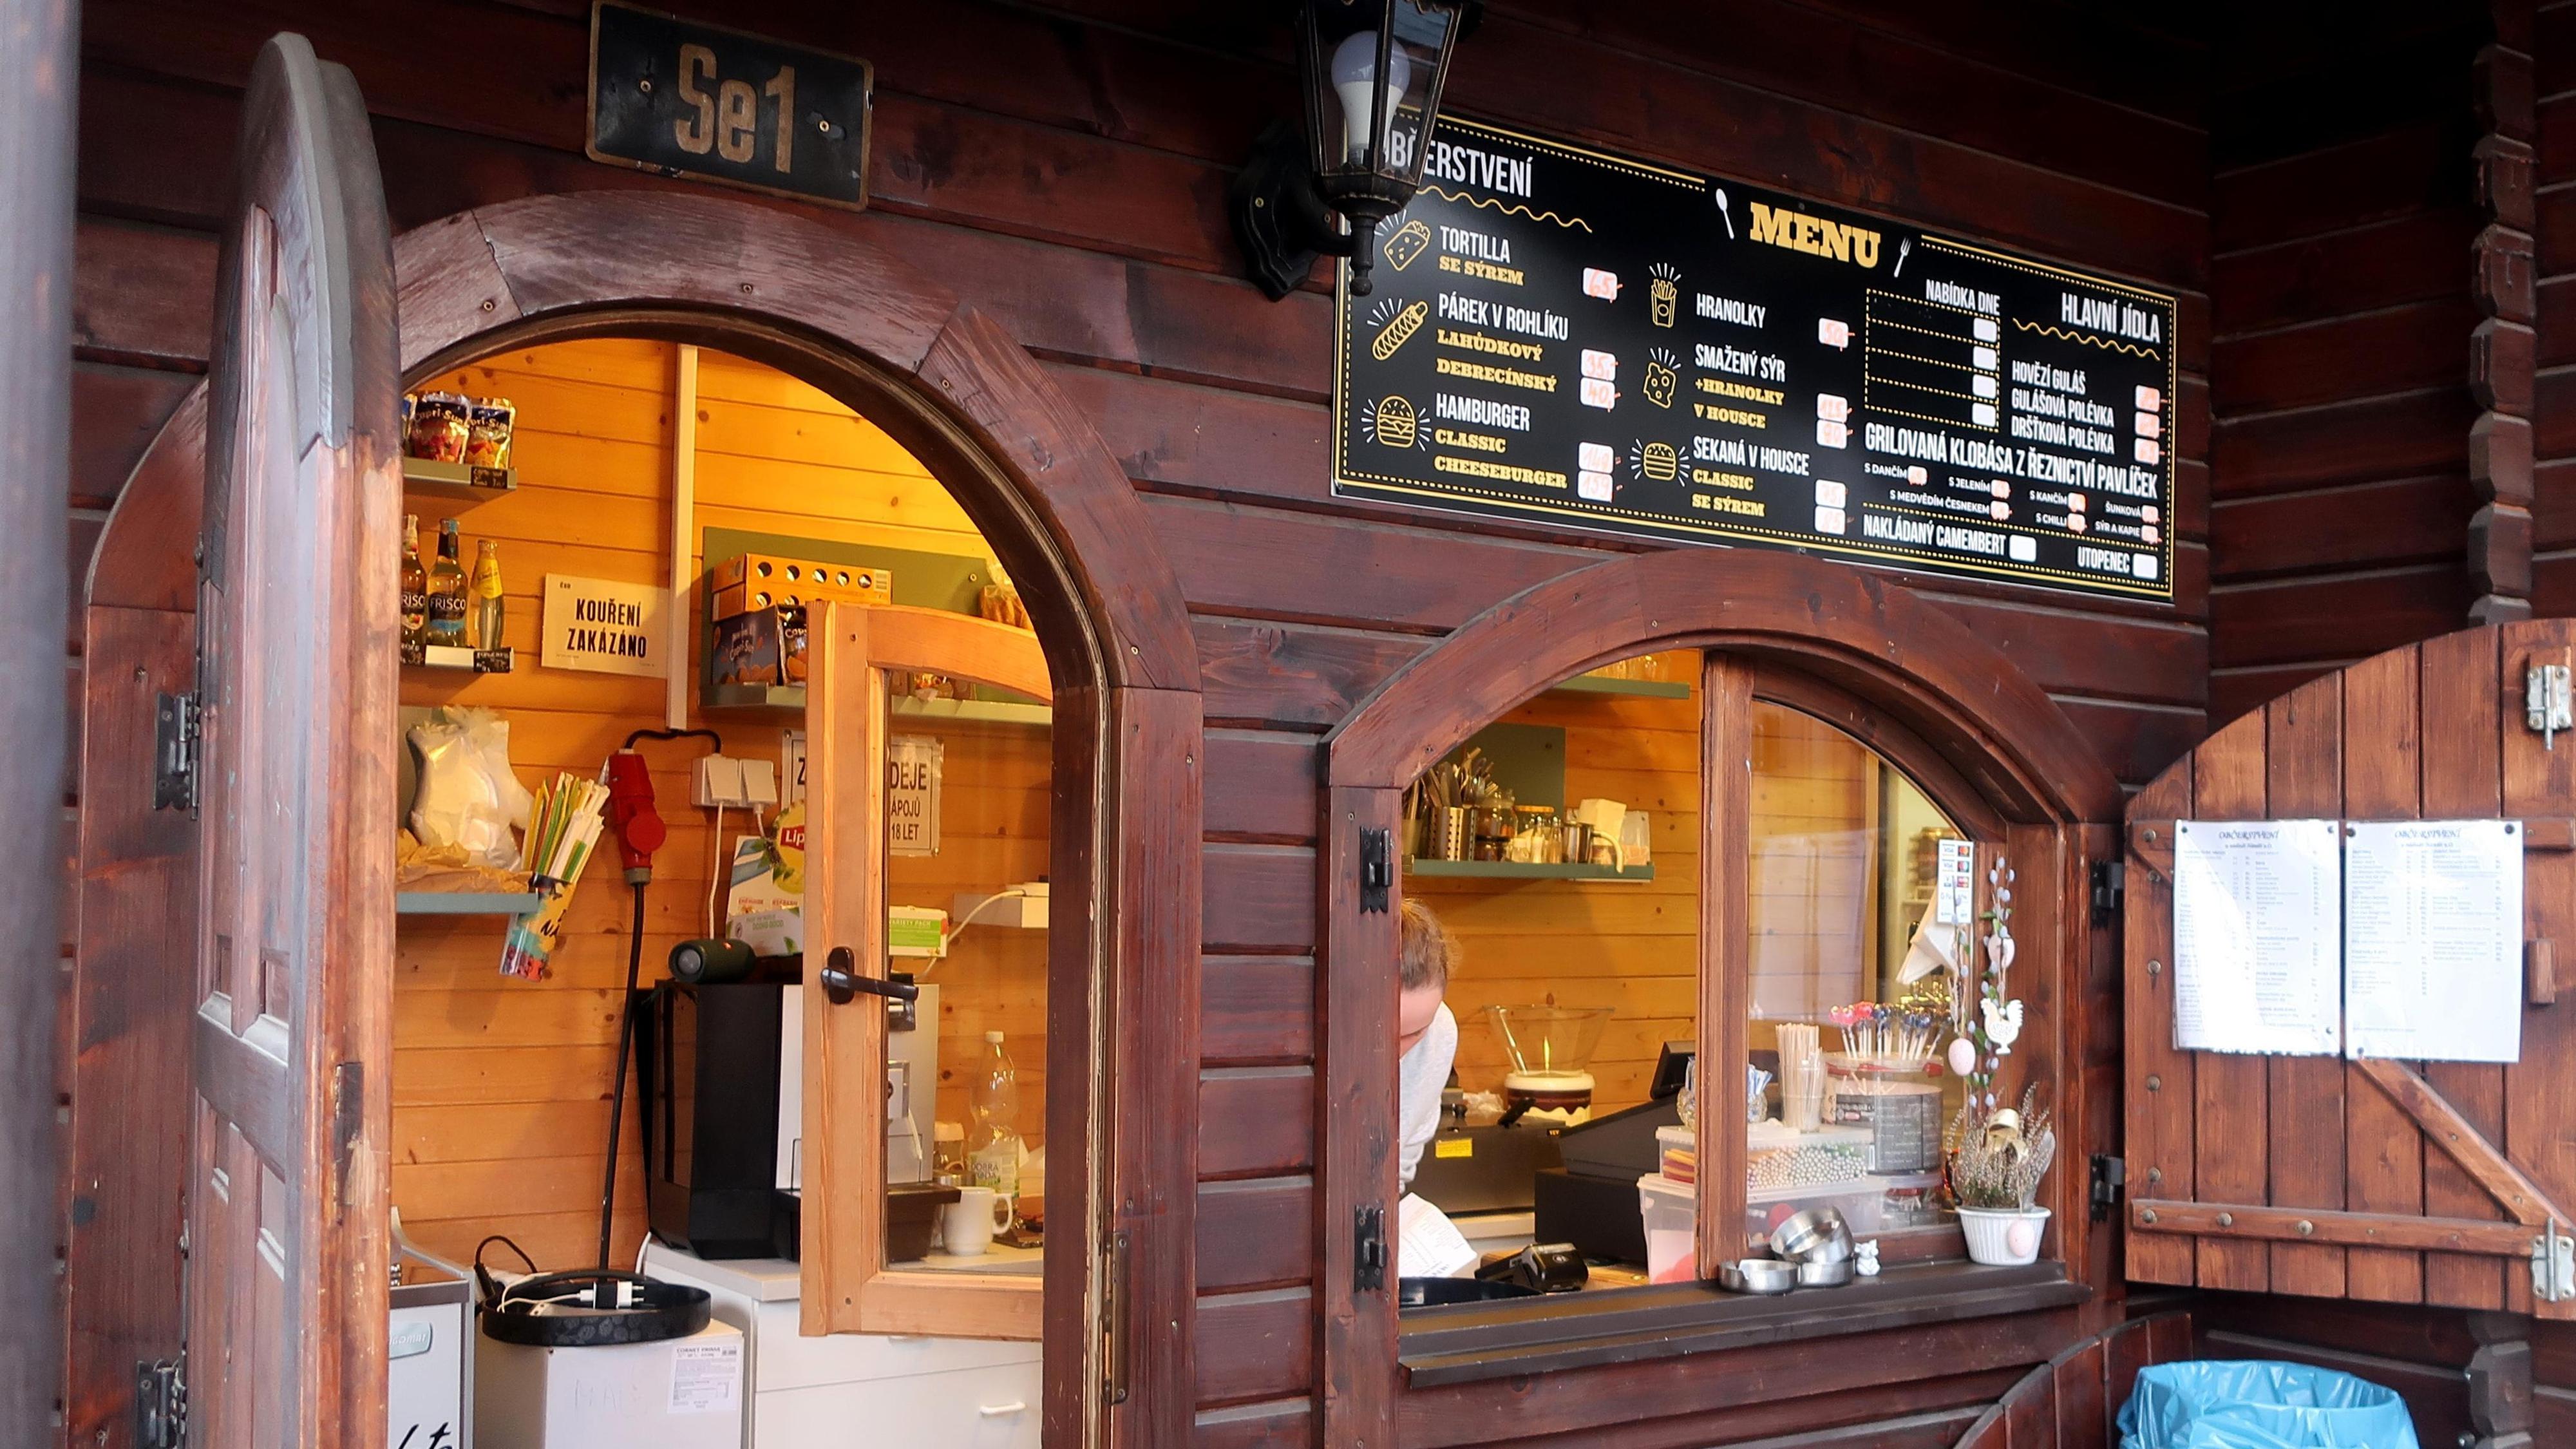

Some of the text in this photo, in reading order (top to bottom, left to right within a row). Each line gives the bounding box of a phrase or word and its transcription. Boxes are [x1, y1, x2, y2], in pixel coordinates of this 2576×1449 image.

[675, 43, 795, 174] Se1
[1439, 225, 1511, 264] TORTILLA
[1750, 202, 1881, 269] MENU
[1439, 255, 1524, 286] SE SÝREM
[1696, 292, 1766, 329] HRANOLKY
[1926, 278, 2001, 316] NABÍDKA DNE
[1438, 291, 1569, 341] PÁREK V ROHLÍKU
[2061, 292, 2161, 344] HLAVNÍ JÍDLA
[1437, 328, 1543, 362] LAHŮDKOVÝ
[1436, 357, 1557, 392] DEBRECÍNSKÝ
[1695, 343, 1786, 383] SMAŽENÝ SÝR
[2012, 359, 2087, 395] HOVĚZÍ GULÁŠ
[1695, 377, 1785, 406] +HRANOLKY
[2011, 388, 2067, 419] GULÁŠOVÁ
[2067, 399, 2115, 428] POLÉVKA
[1435, 393, 1531, 431] HAMBURGER
[1694, 403, 1766, 429] V HOUSCE
[1434, 429, 1506, 453] CLASSIC
[2011, 415, 2067, 446] DRŠŤKOVÁ
[2068, 426, 2115, 455] POLÉVKA
[1434, 455, 1568, 489] CHEESEBURGER
[1693, 435, 1810, 476] SEKANÁ V HOUSCE
[1864, 422, 1947, 463] GRILOVANÁ
[1949, 436, 2014, 475] KLOBÁSA
[2015, 450, 2026, 477] Z
[2027, 446, 2096, 489] ŘEZNICTVÍ
[2097, 464, 2157, 500] PAVLÍČEK
[1864, 462, 1871, 473] S
[1872, 464, 1908, 479] DANČÍM
[1692, 469, 1754, 491] CLASSIC
[1948, 476, 1955, 487] S
[1955, 478, 1991, 491] JELENÍM
[1692, 494, 1765, 517] SE SÝREM
[1889, 489, 1896, 500] S
[1897, 489, 1944, 507] MEDVĚDÍM
[1944, 495, 1990, 513] ČESNEKEM
[2029, 490, 2036, 500] S
[2036, 490, 2068, 505] KANČÍM
[2105, 500, 2141, 516] ŠUNKOVÁ
[1863, 514, 2006, 556] NAKLÁDANÝ CAMEMBERT
[2036, 513, 2041, 523] S
[2042, 514, 2067, 527] CHILLI
[2095, 519, 2110, 532] SÝR
[2111, 524, 2117, 533] A
[2077, 545, 2131, 574] UTOPENEC
[430, 596, 466, 611] FRISCO
[576, 598, 641, 627] KOUŘENÍ
[567, 627, 647, 659] ZAKÁZÁNO
[891, 822, 920, 840] 18 LET
